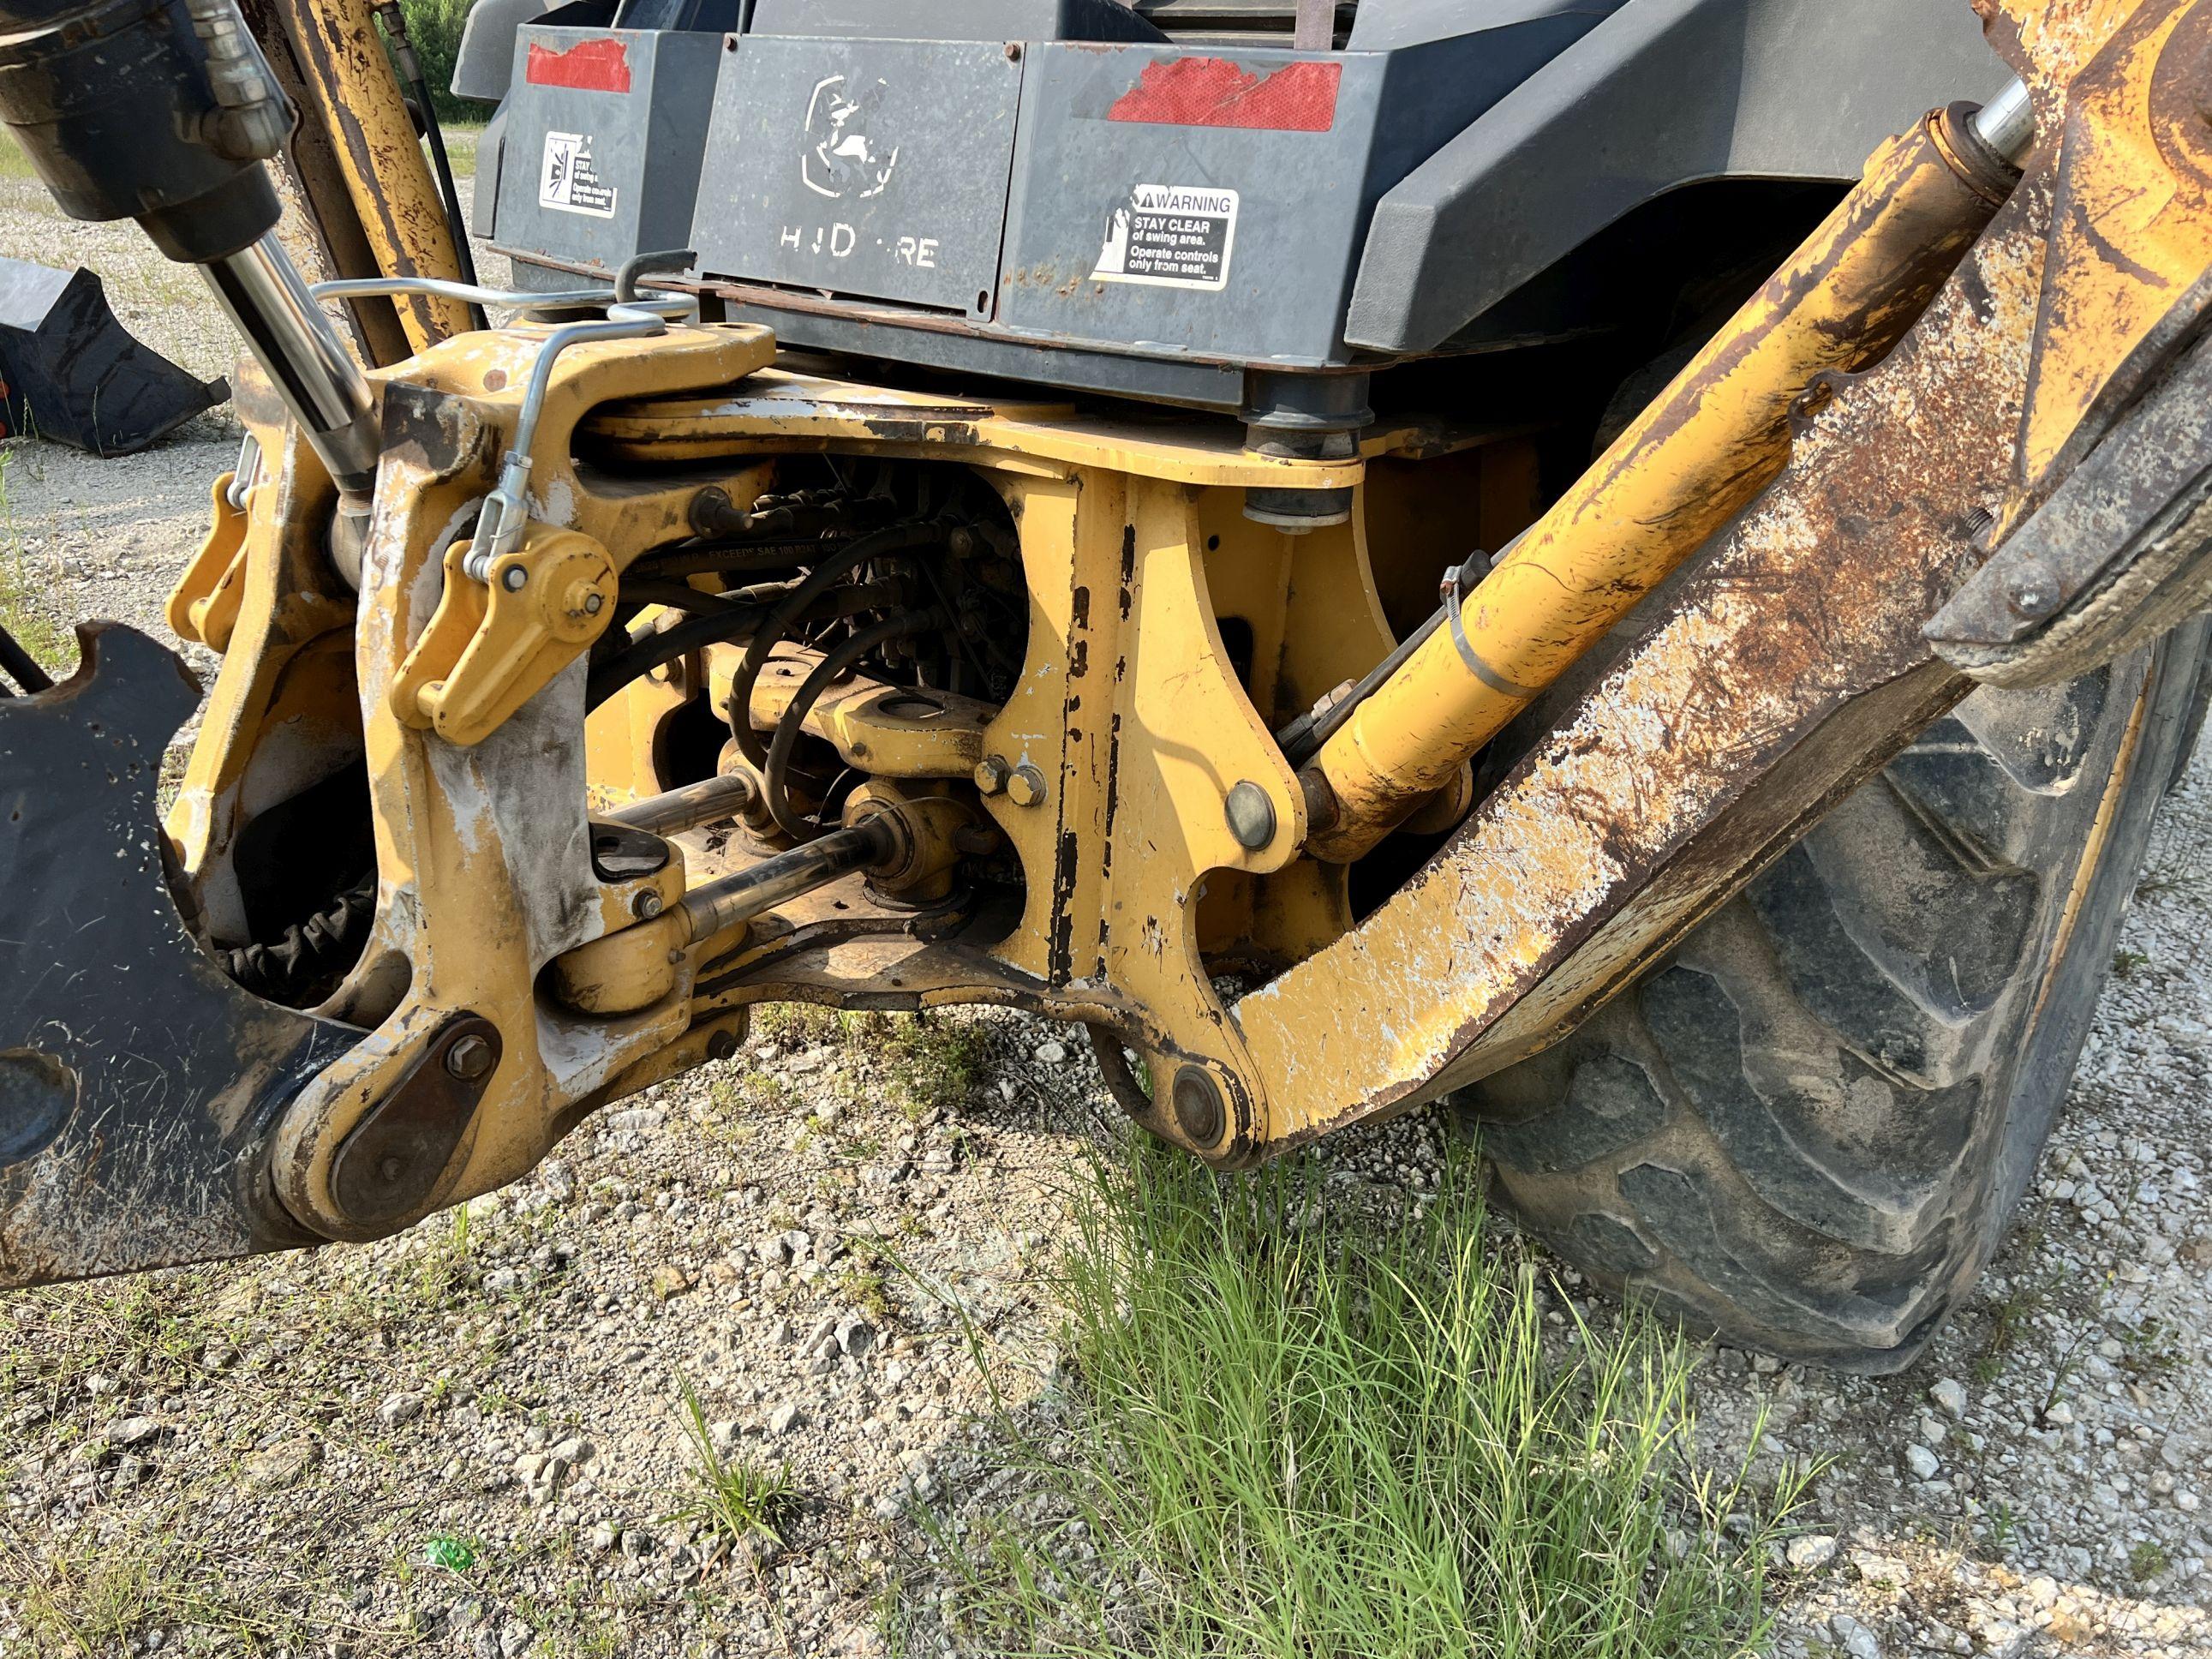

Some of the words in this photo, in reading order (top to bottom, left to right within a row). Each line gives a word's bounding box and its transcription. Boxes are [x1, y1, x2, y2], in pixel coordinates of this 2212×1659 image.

[575, 160, 590, 171] STAY
[573, 183, 592, 194] Operate
[571, 194, 583, 203] only
[583, 195, 595, 204] from
[1157, 194, 1231, 213] WARNING
[1134, 217, 1167, 230] STAY
[1169, 219, 1211, 234] CLEAR
[830, 222, 940, 268] DRE
[1133, 230, 1144, 241] of
[1145, 231, 1177, 246] swing
[1179, 234, 1205, 245] area.
[1130, 245, 1172, 260] Operate
[1174, 249, 1218, 263] controls
[1129, 258, 1151, 272] only
[1154, 260, 1179, 272] from
[1181, 263, 1206, 274] seat.
